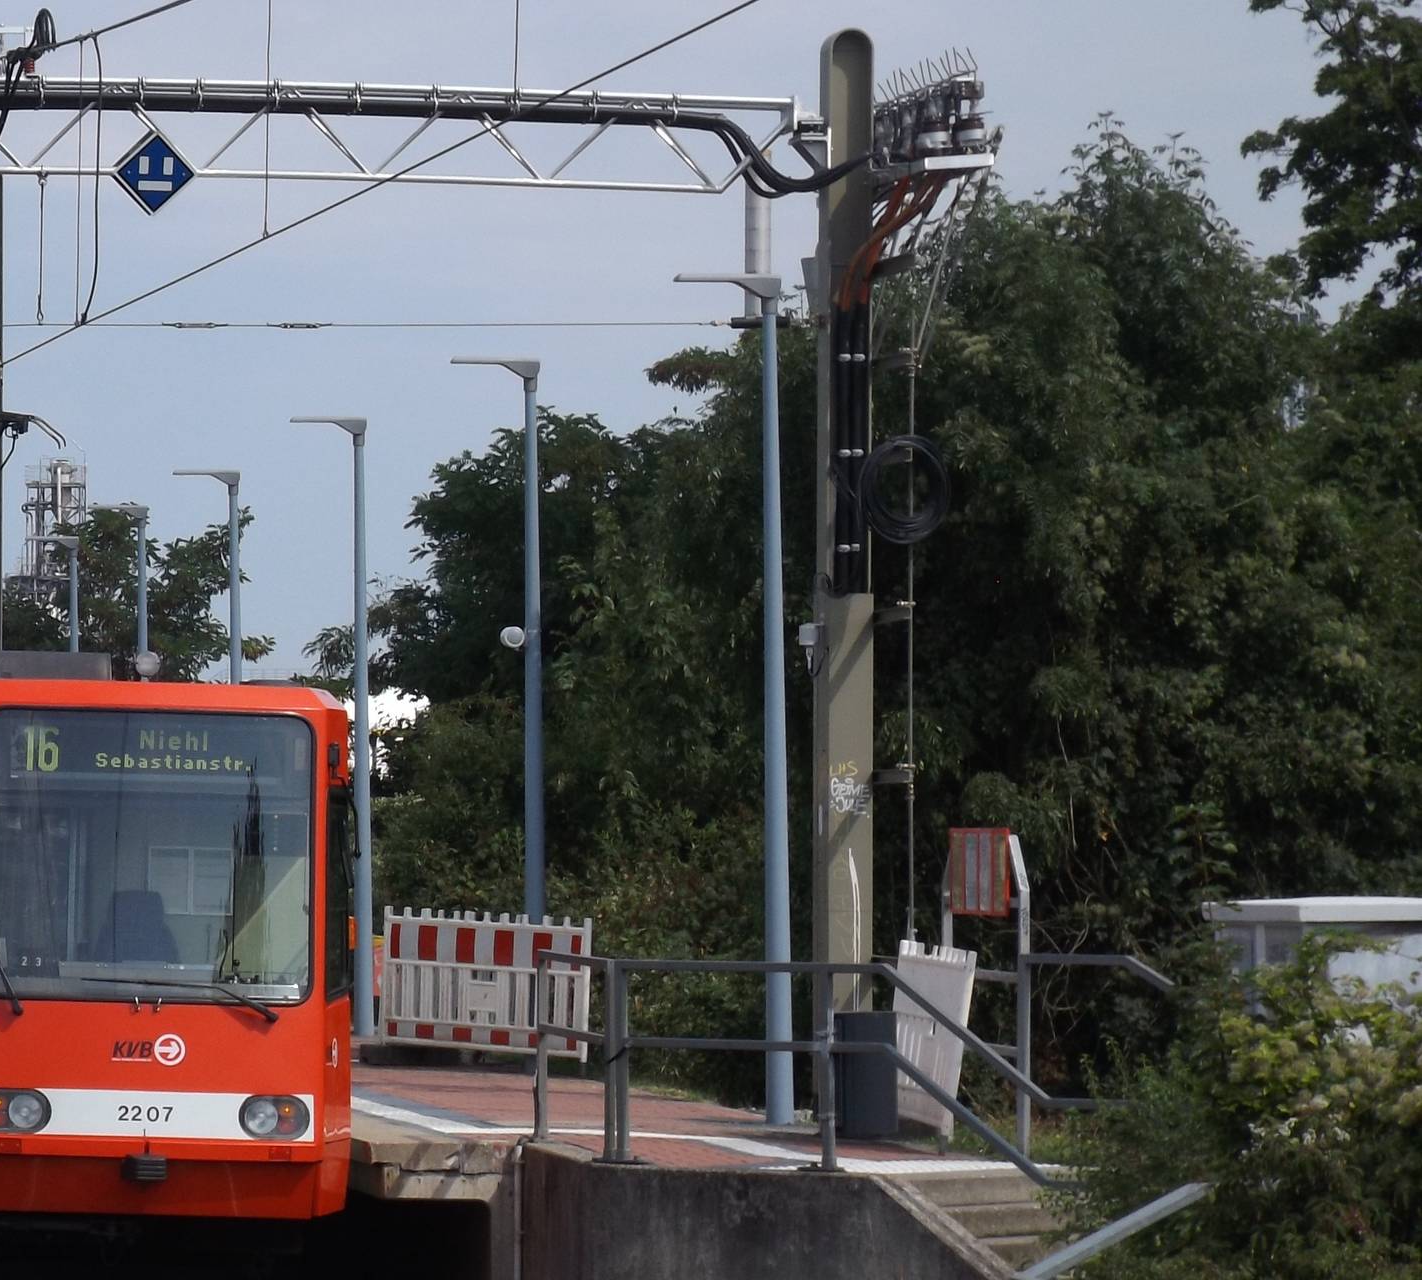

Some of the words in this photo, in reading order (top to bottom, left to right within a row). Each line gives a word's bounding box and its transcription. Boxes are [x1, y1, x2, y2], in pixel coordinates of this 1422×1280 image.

[25, 726, 59, 772] 16
[139, 730, 209, 752] Niehl
[95, 752, 252, 772] Sebastianstr.
[112, 1041, 153, 1058] KVB
[118, 1105, 174, 1122] 2207
